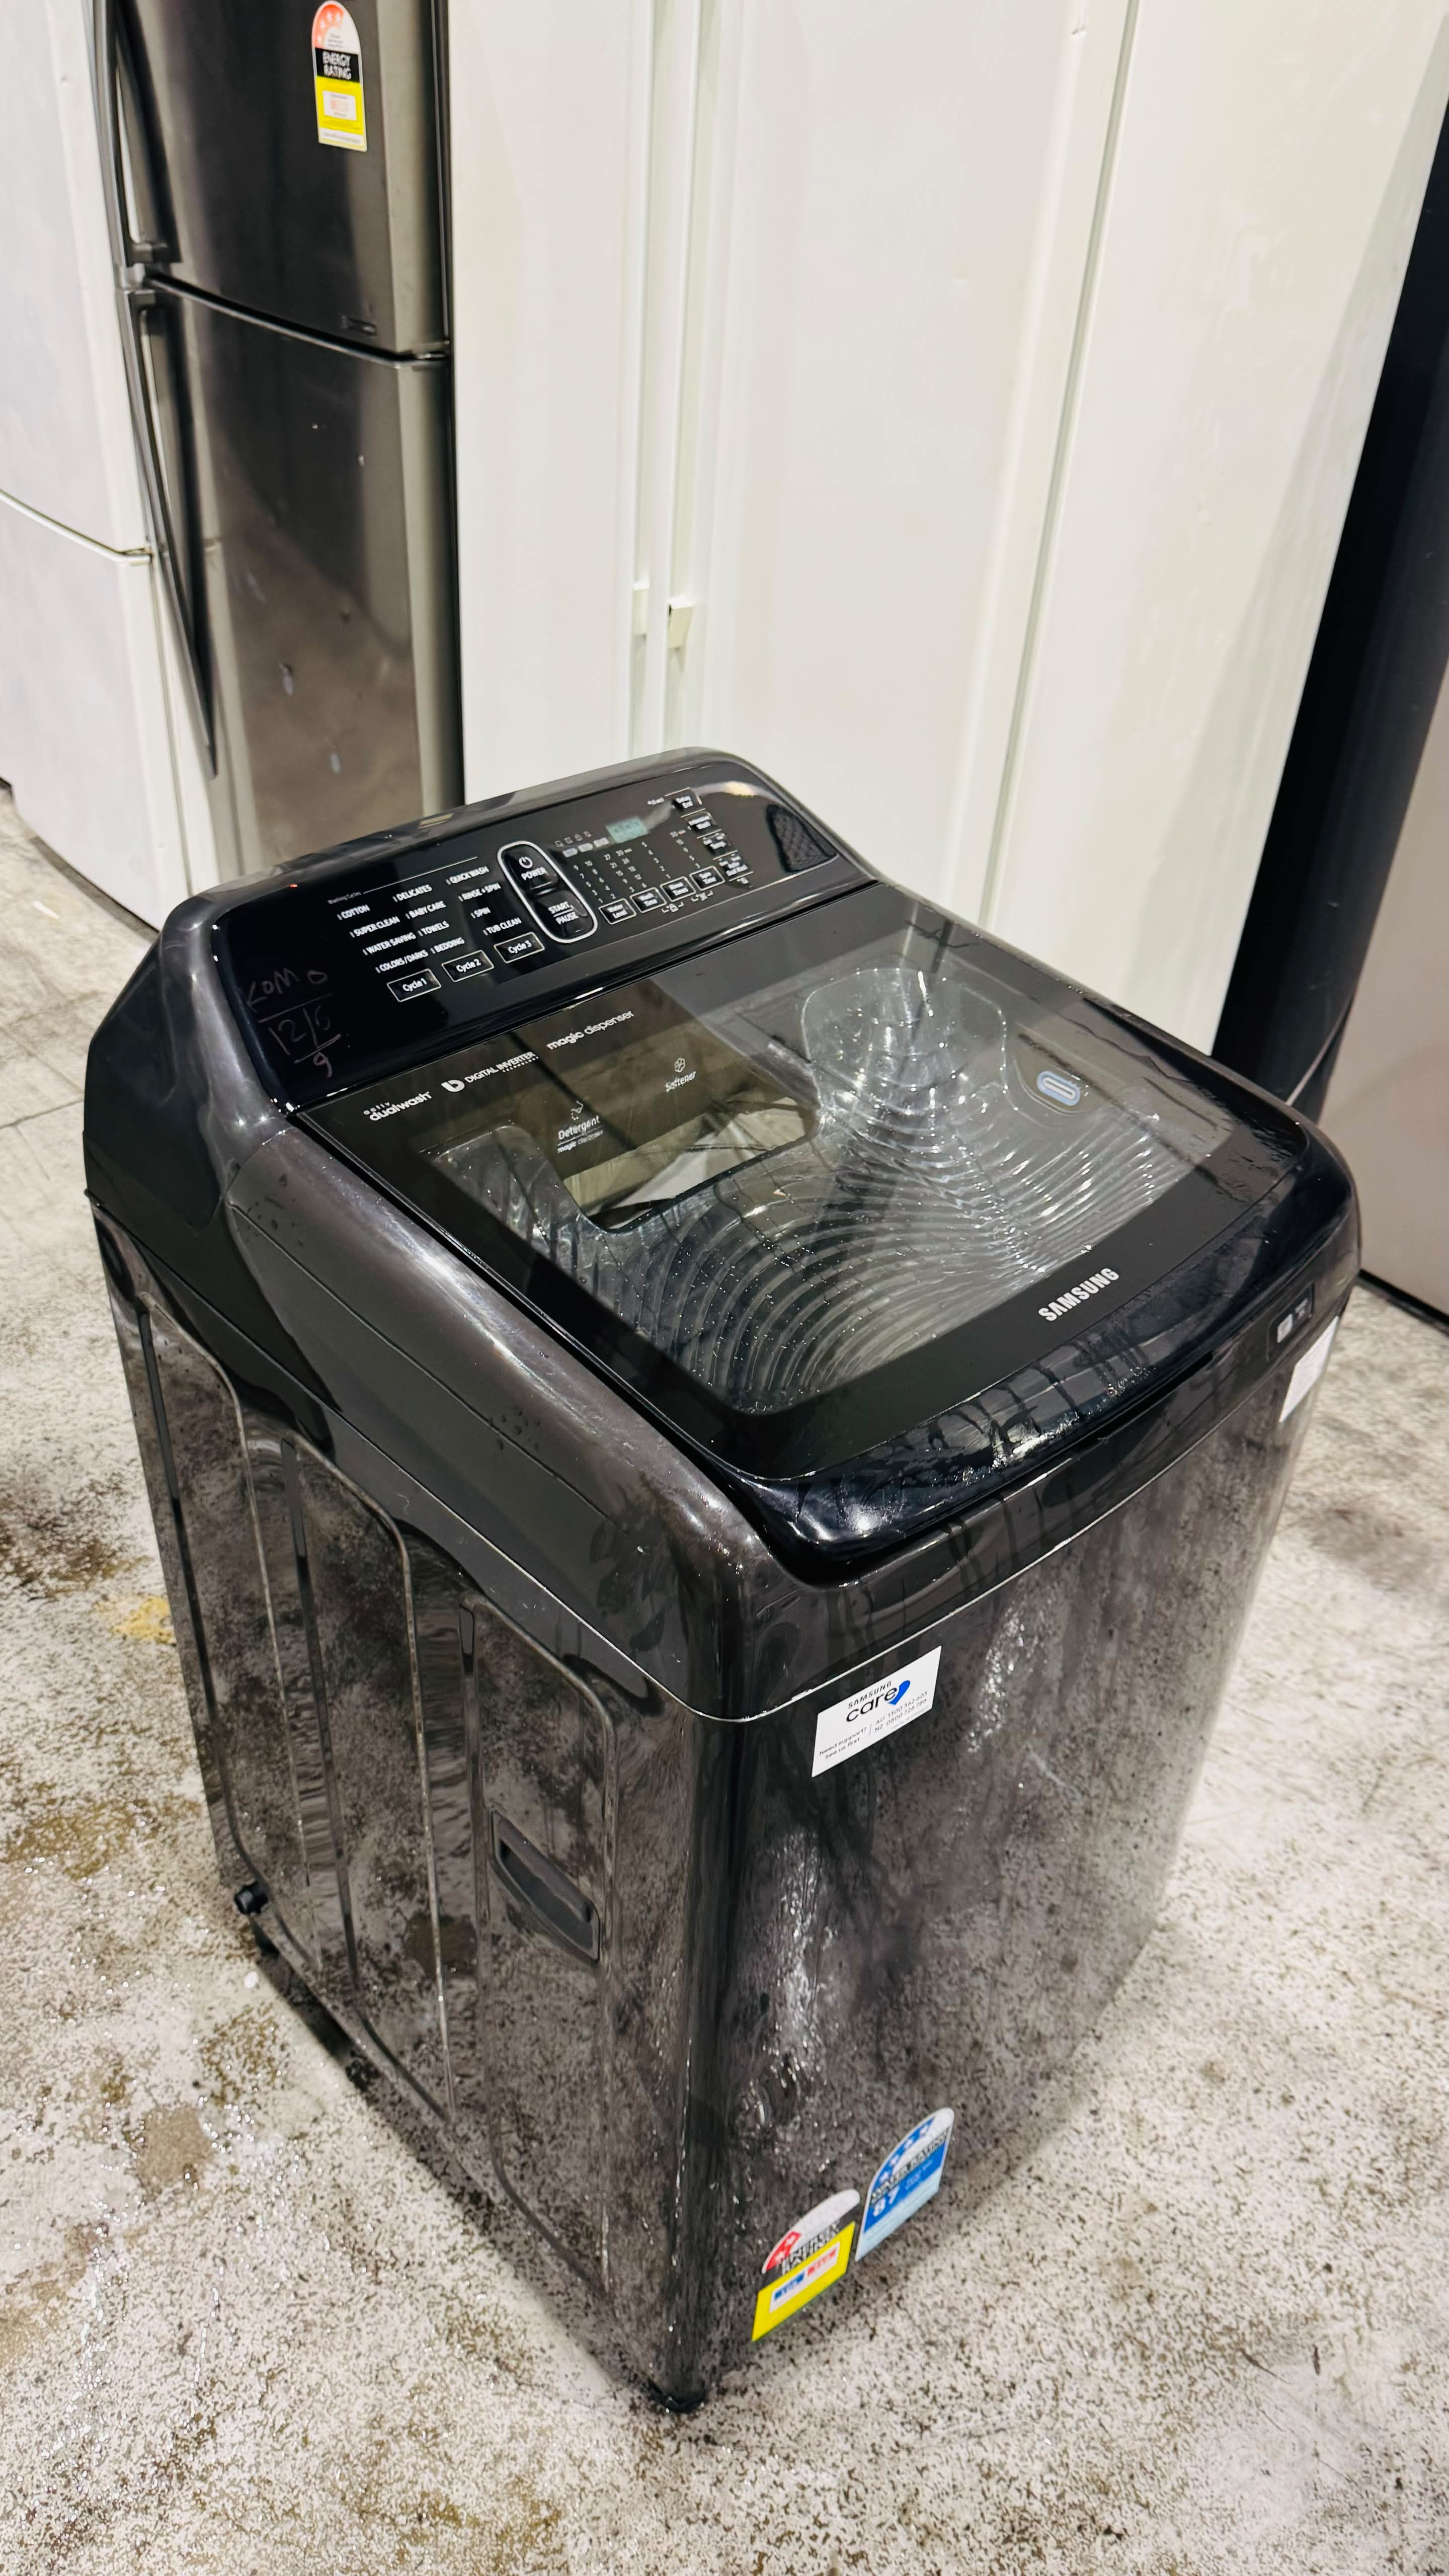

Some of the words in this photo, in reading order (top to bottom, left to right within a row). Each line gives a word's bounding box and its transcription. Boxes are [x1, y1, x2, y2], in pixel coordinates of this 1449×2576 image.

[322, 51, 351, 67] ENERGY
[324, 64, 351, 80] RATING
[449, 871, 471, 884] QUICK
[469, 866, 490, 878] WASH
[521, 866, 548, 880] POWER
[396, 884, 432, 901] DELICATES
[461, 889, 482, 901] RINSE
[485, 882, 501, 894] SPIN
[341, 904, 370, 919] COTTON
[409, 906, 428, 918] BABY
[427, 901, 447, 912] CARE
[474, 907, 491, 918] SPIN
[548, 901, 574, 914] START
[353, 923, 378, 937] SUPER
[376, 916, 400, 929] CLEAN
[486, 923, 501, 934] TUB
[500, 917, 522, 929] CLEAN
[555, 912, 579, 925] PAUSE
[421, 920, 450, 935] TOWELS
[366, 939, 391, 954] WATER
[390, 932, 417, 947] SAVING
[434, 937, 465, 953] BEDDING
[508, 943, 527, 954] Cycle
[525, 940, 532, 948] 3
[456, 961, 475, 973] Cycle
[402, 979, 423, 992] Cycle
[546, 1031, 585, 1050] magic
[584, 1011, 634, 1035] dispenser
[464, 1067, 499, 1083] DIGITAL
[496, 1051, 536, 1071] INVERTER
[665, 1071, 697, 1093] Softener
[369, 1091, 432, 1121] dualwash
[558, 1114, 600, 1140] Detergent
[1038, 1268, 1119, 1321] SAMSUNG
[848, 1680, 893, 1710] SAMSUNG
[846, 1687, 898, 1723] care
